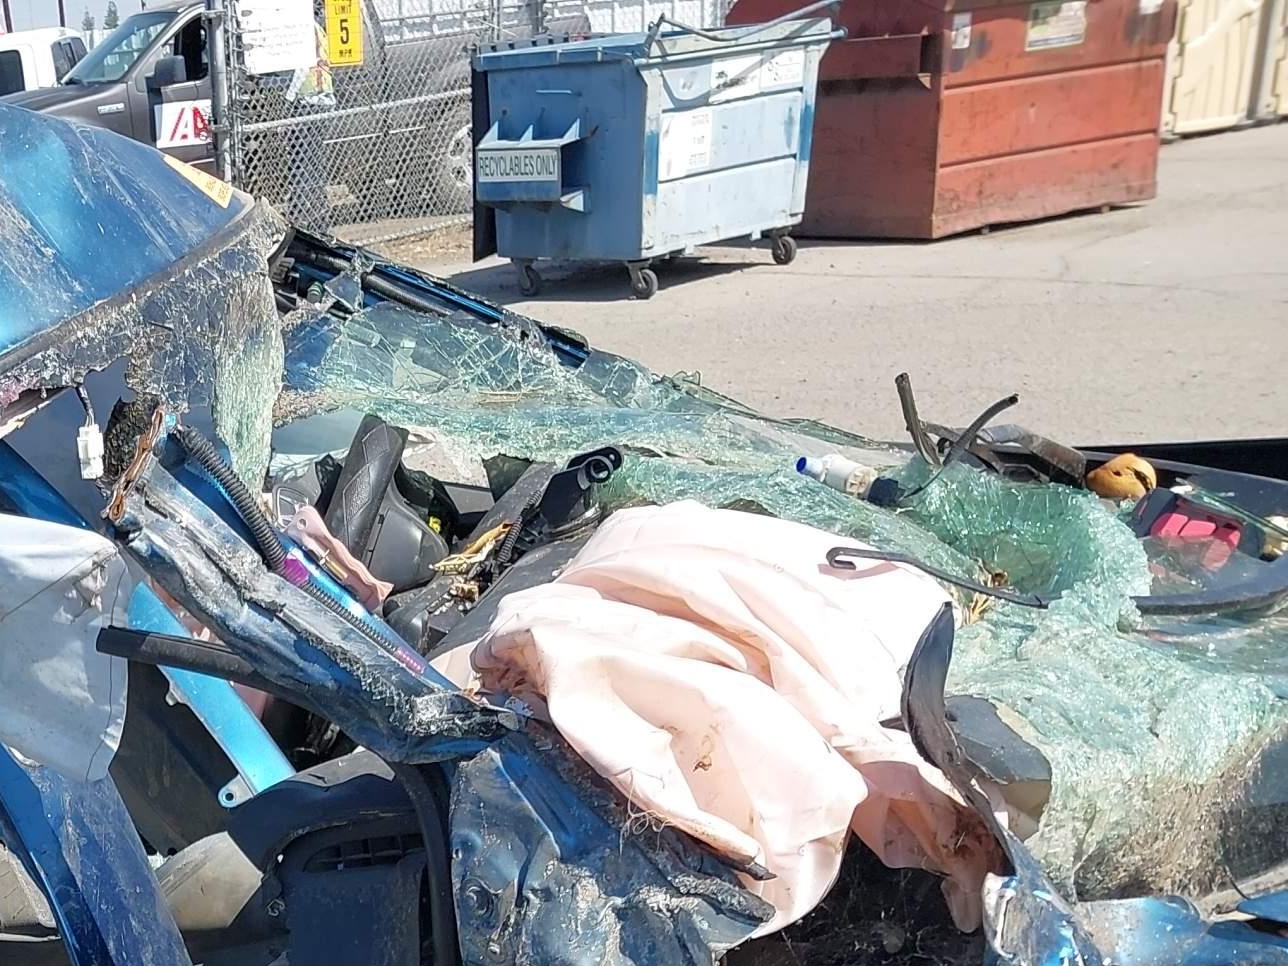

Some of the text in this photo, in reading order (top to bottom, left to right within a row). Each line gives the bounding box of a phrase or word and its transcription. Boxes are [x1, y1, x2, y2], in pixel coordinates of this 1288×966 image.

[339, 18, 350, 45] 5
[479, 154, 558, 177] RECYCLABLES ONLY
